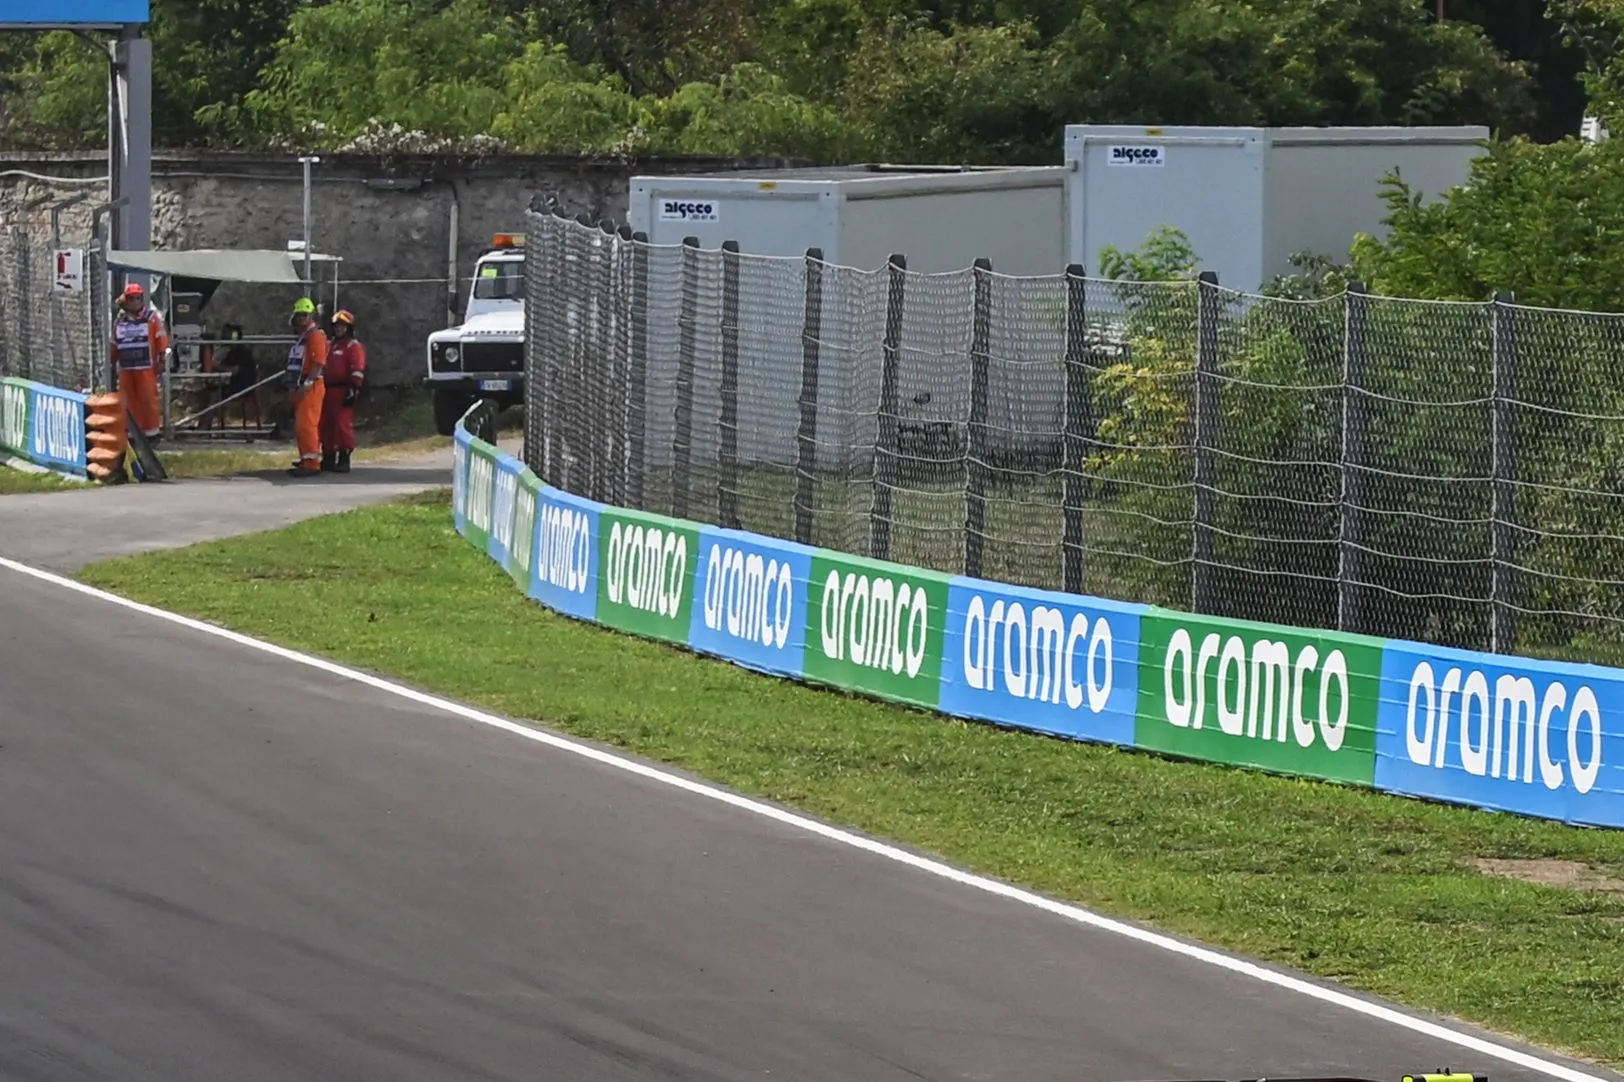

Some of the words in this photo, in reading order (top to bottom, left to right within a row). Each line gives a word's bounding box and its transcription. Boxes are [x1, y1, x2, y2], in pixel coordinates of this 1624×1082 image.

[538, 503, 589, 594] aramco
[607, 521, 687, 619] aramco
[704, 543, 792, 650] aramco
[821, 570, 927, 679] aramco
[964, 595, 1113, 713] aramco
[1164, 628, 1349, 751] aramco
[1406, 661, 1601, 794] aramco
